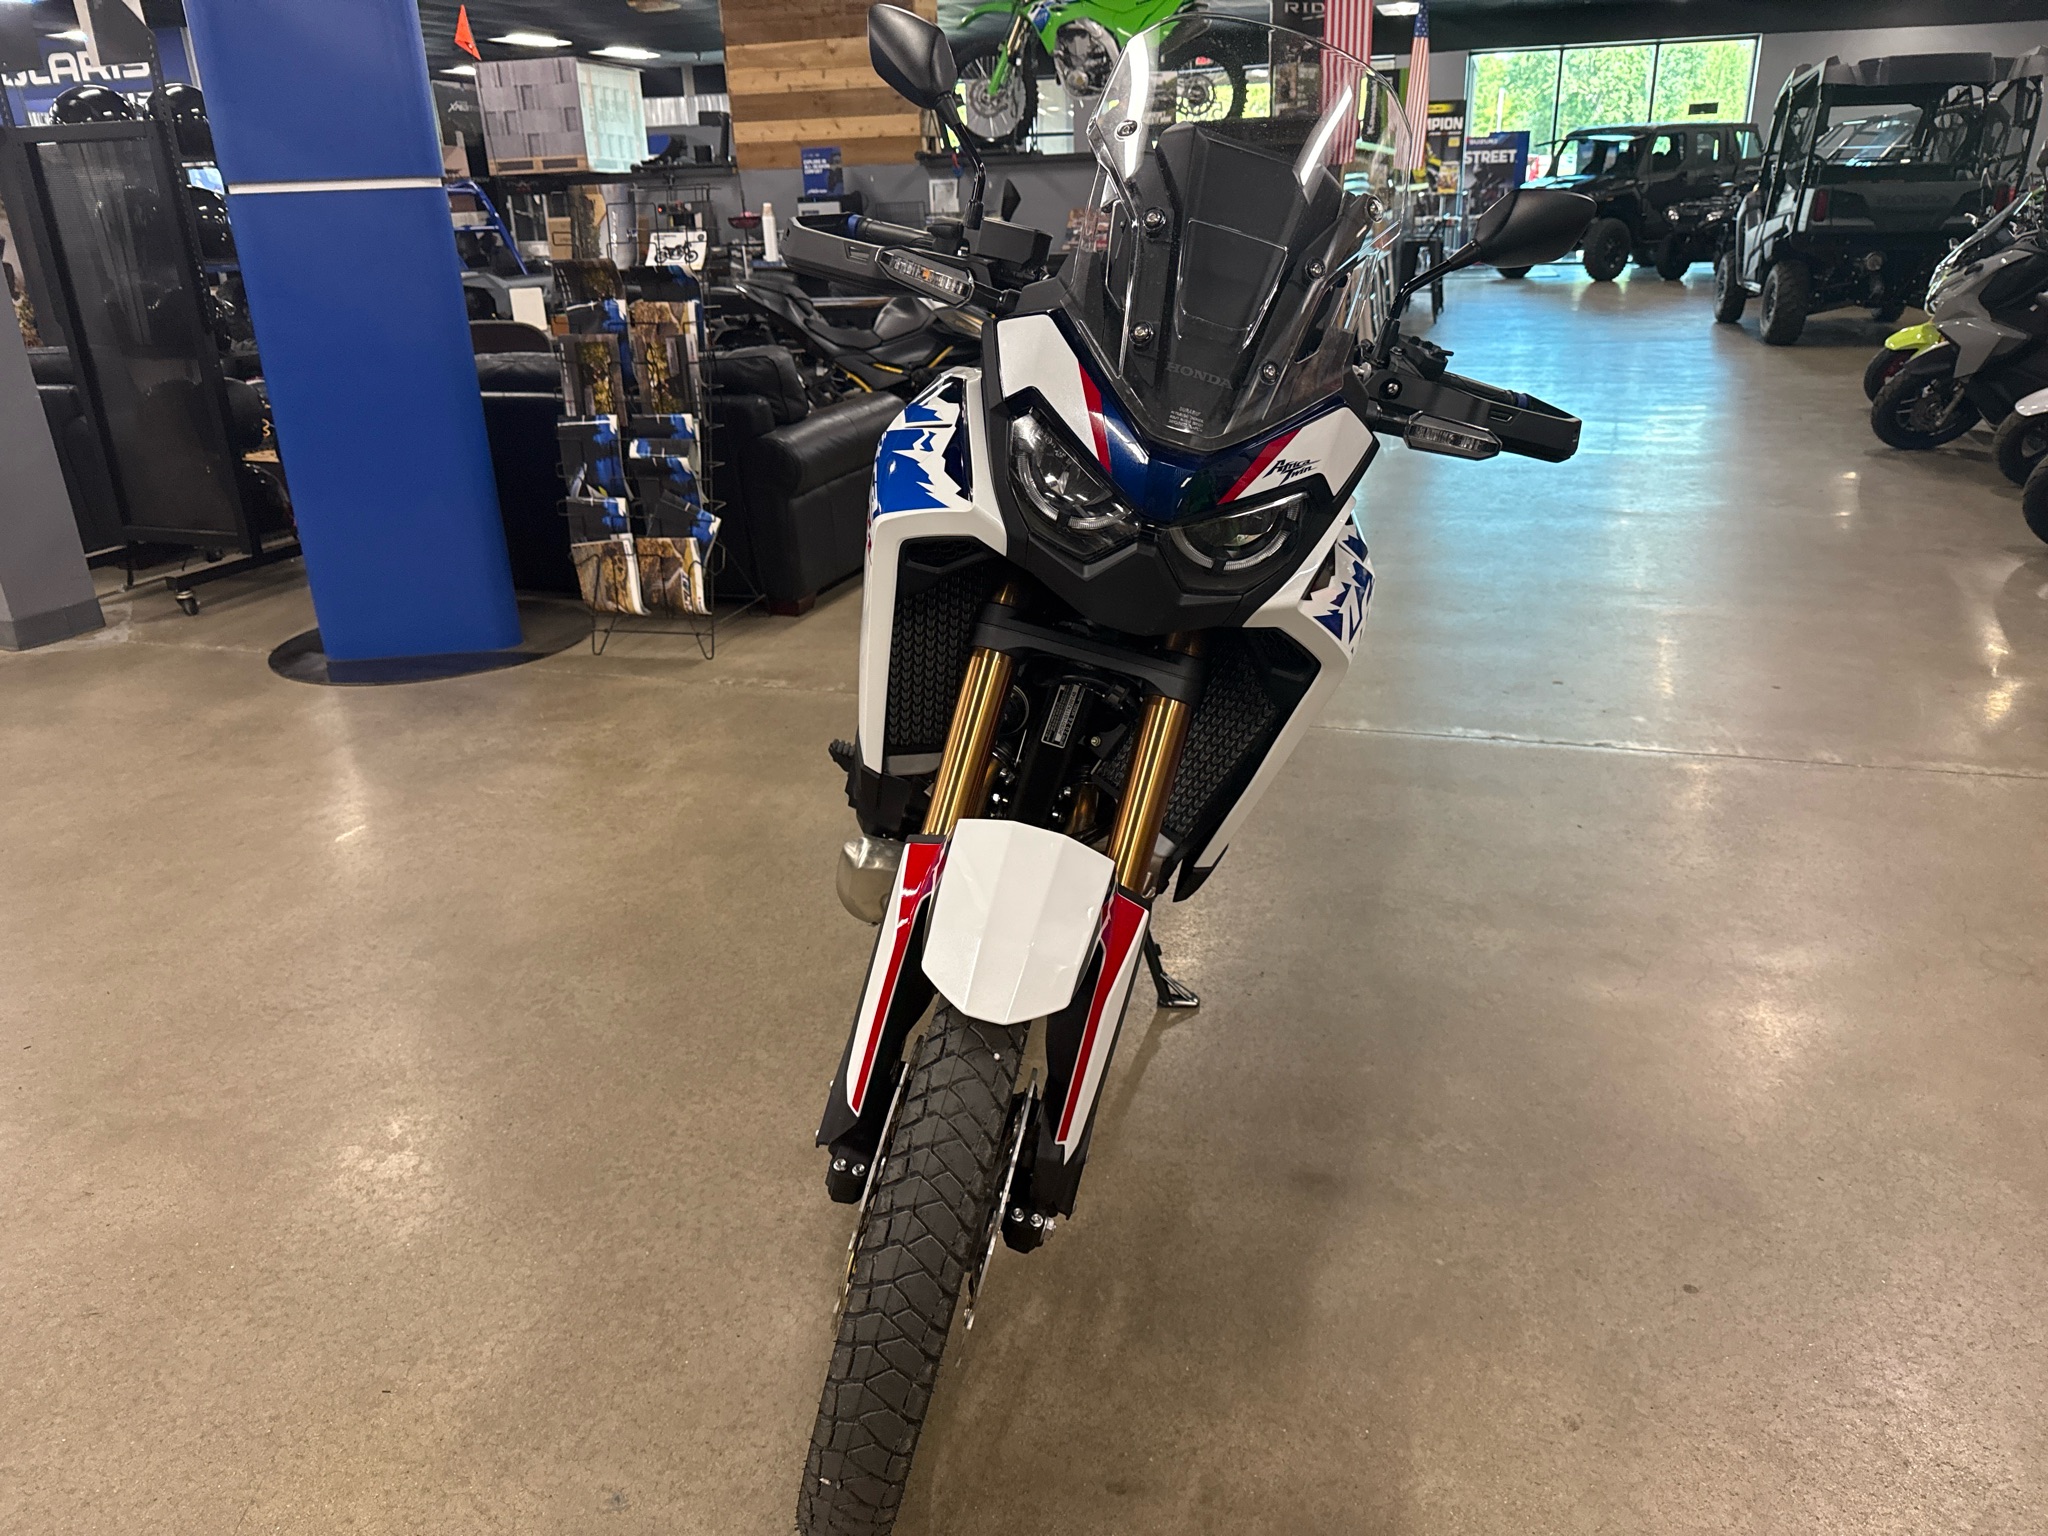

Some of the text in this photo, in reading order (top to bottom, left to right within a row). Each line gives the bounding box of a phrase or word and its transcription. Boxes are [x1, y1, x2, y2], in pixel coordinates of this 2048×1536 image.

[1284, 1, 1325, 14] RID
[1464, 148, 1518, 165] STREET
[1165, 361, 1233, 390] HONDA
[1262, 458, 1322, 479] Africa
[1278, 465, 1318, 487] Twin
